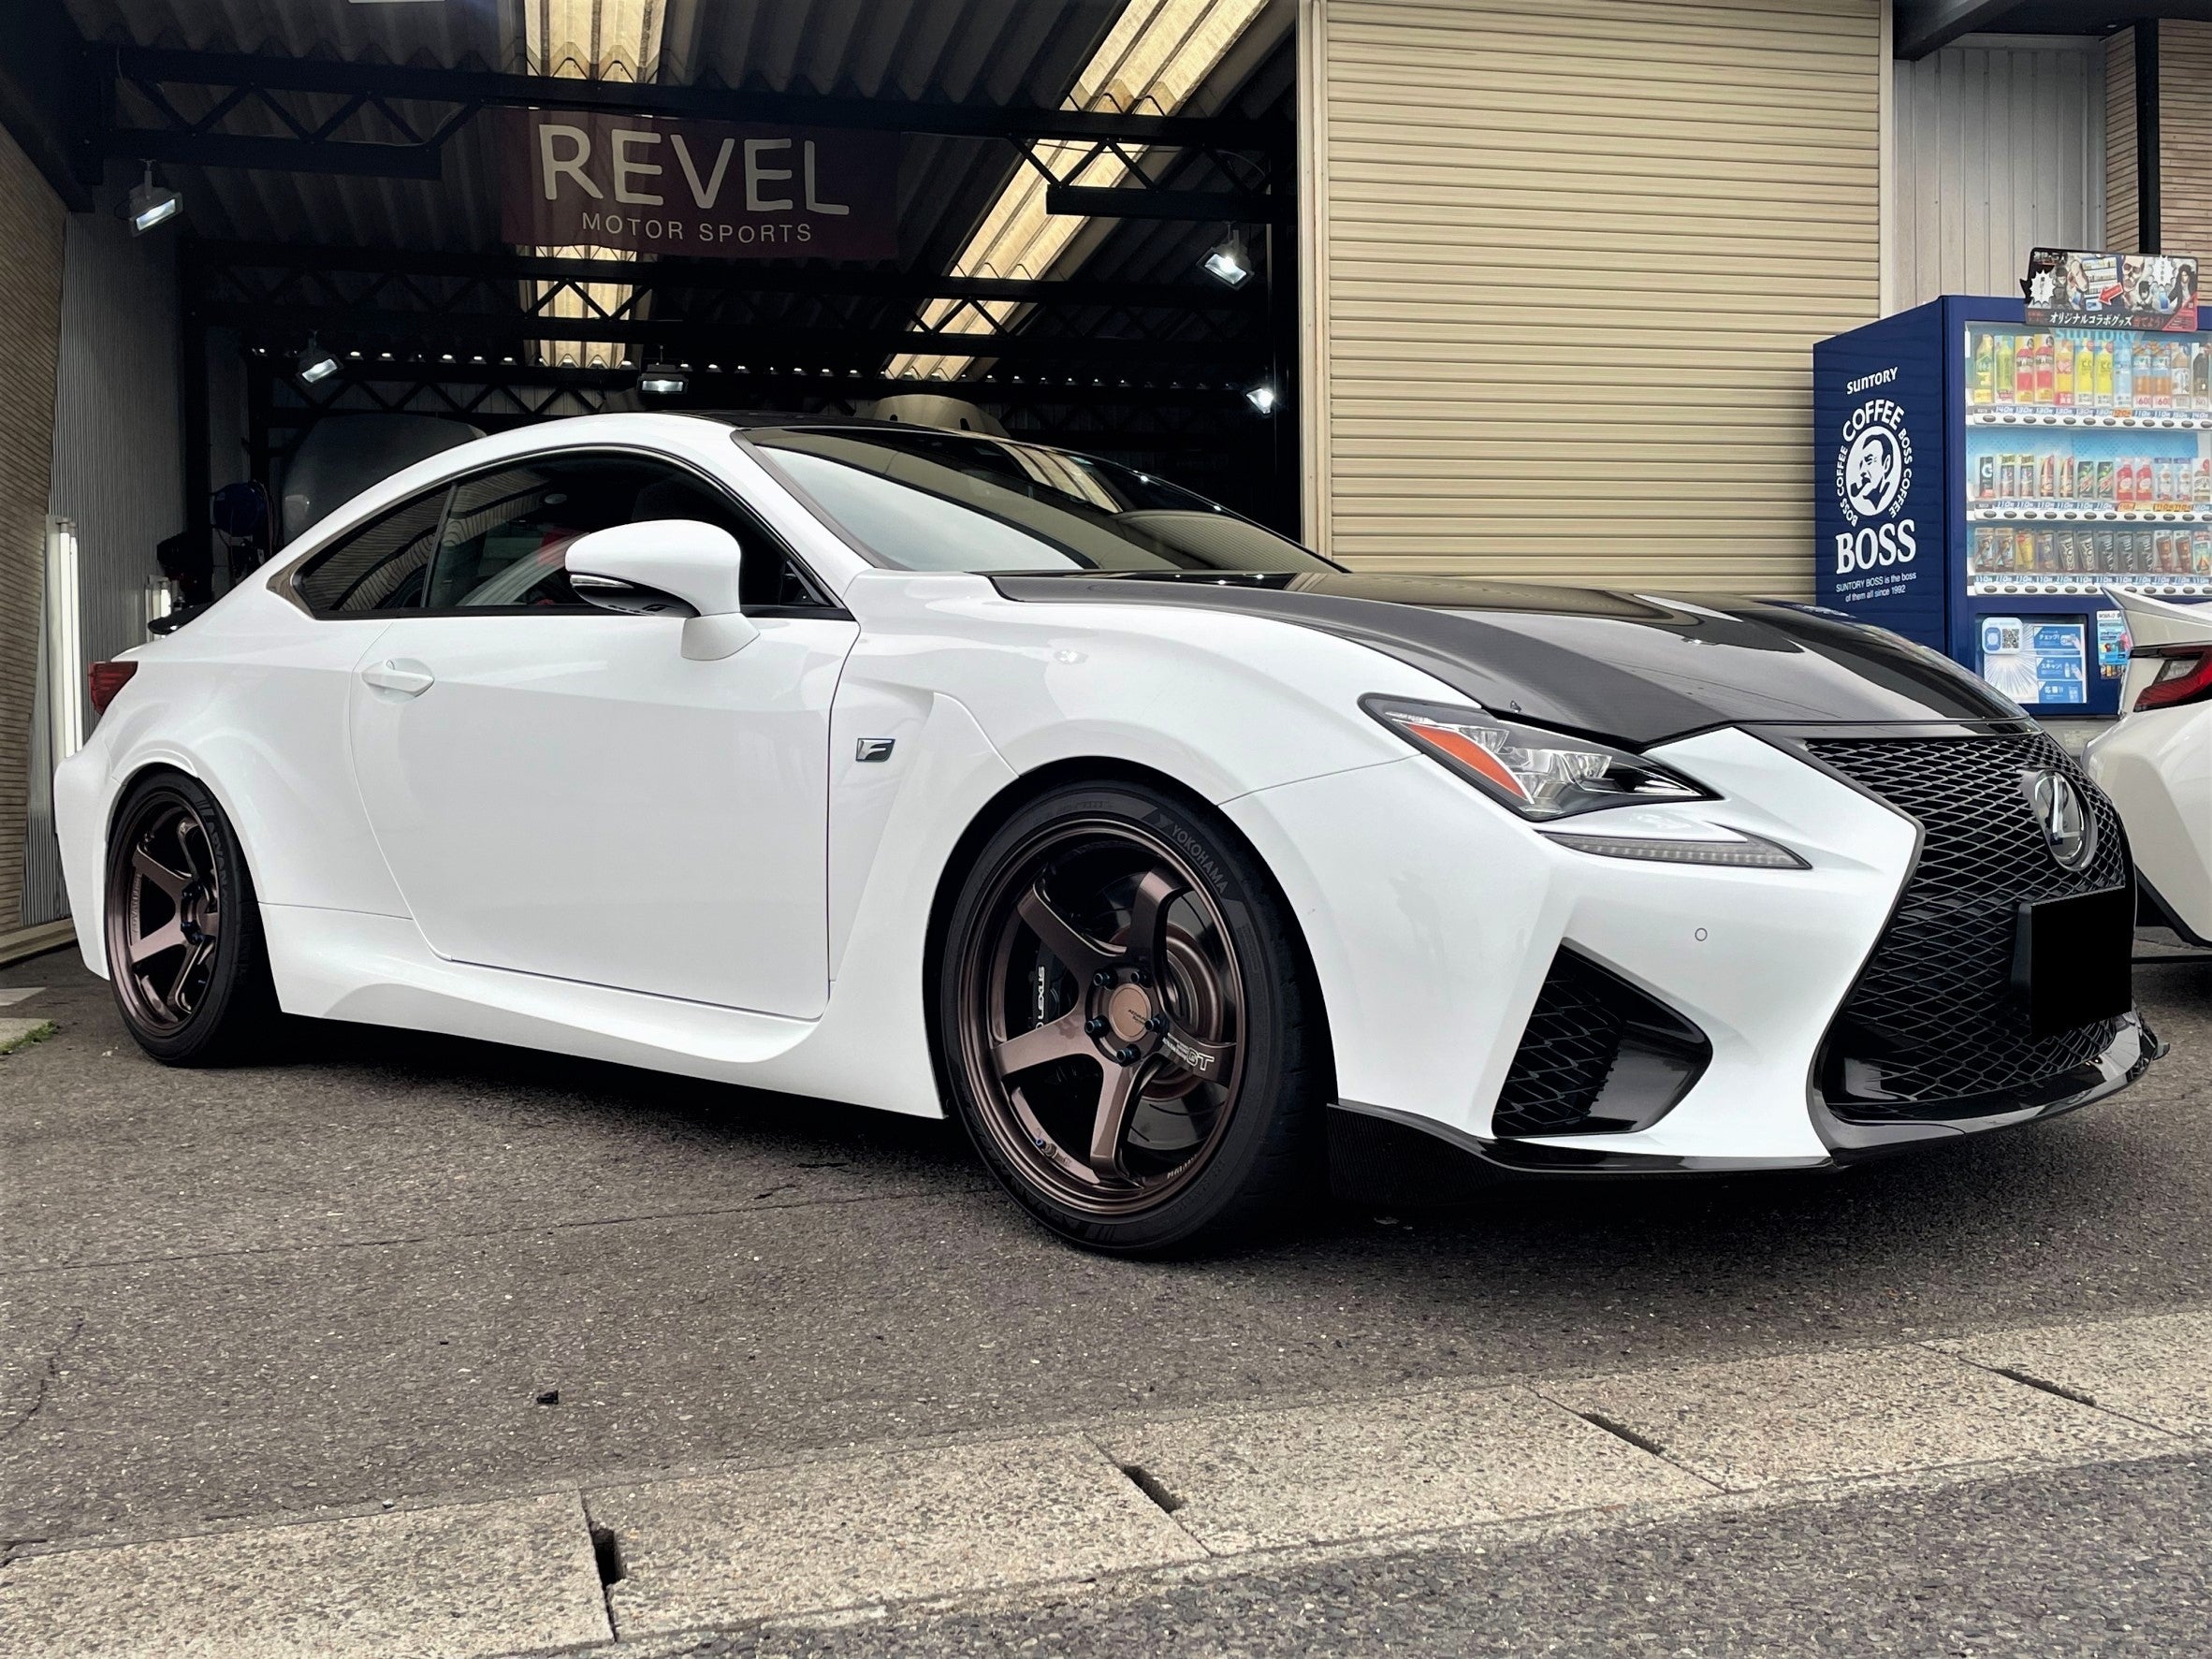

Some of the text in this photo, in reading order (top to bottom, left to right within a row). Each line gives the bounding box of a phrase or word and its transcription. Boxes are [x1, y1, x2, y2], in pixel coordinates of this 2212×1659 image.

[539, 124, 851, 215] REVEL
[582, 211, 812, 243] MOTOR SPORTS
[1842, 399, 1905, 442] COFFEE
[1898, 428, 1913, 465] BOSS
[1836, 445, 1849, 497] COFFEE
[1840, 498, 1858, 527] BOSS
[1888, 468, 1913, 518] COFFEE
[1835, 518, 1916, 575] BOSS
[1836, 572, 1917, 592] SUNTORY BOSS is the boss
[1845, 594, 1852, 603] of
[1852, 591, 1866, 602] them
[1874, 588, 1890, 598] since
[1891, 585, 1906, 594] 1992
[1171, 824, 1229, 895] YOKOHAMA
[1186, 1047, 1215, 1071] GT
